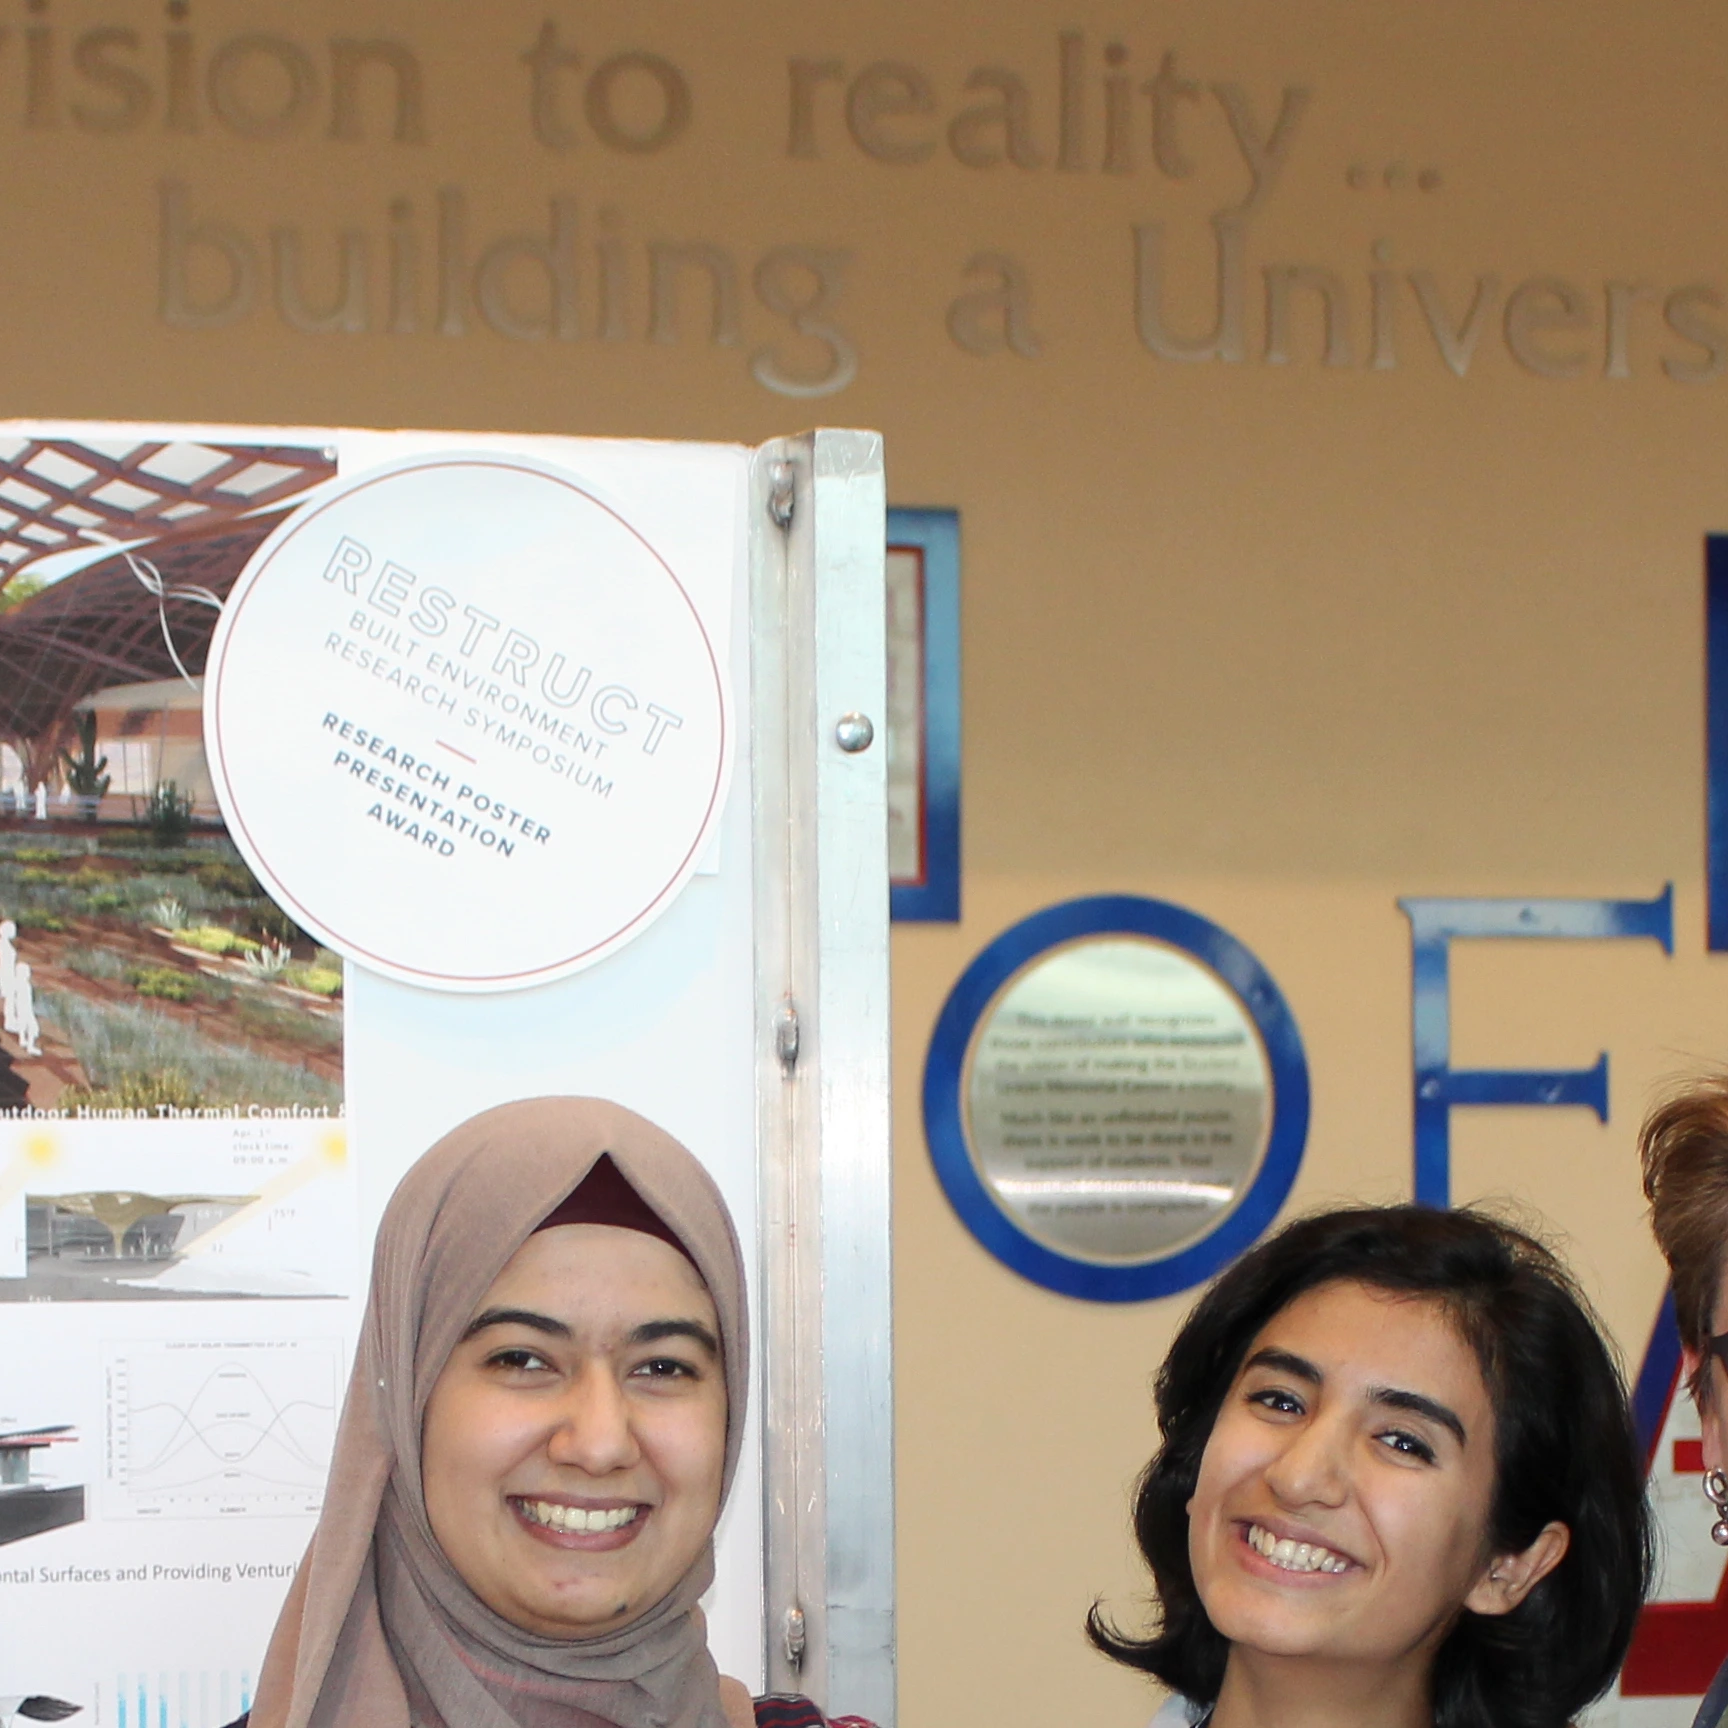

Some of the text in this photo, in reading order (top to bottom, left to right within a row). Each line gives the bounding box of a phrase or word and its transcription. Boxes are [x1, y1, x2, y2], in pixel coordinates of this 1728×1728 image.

[520, 19, 694, 155] to
[155, 176, 862, 398] building
[943, 249, 1040, 360] a
[322, 535, 683, 757] RESTRUCT
[348, 609, 611, 762] BUILT ENVIRONMENT
[322, 711, 552, 846] RESEARCH POSTER
[324, 631, 614, 799] RESEARCH SYMPOSIUM
[333, 749, 517, 859] PRESENTATION
[366, 802, 457, 860] AWARD
[76, 1104, 149, 1120] Human
[155, 1104, 240, 1120] Thermal
[247, 1103, 331, 1120] Comfort
[40, 1564, 111, 1582] Surfaces
[116, 1564, 147, 1581] and
[153, 1563, 232, 1584] Providing
[236, 1561, 296, 1580] Venturi
